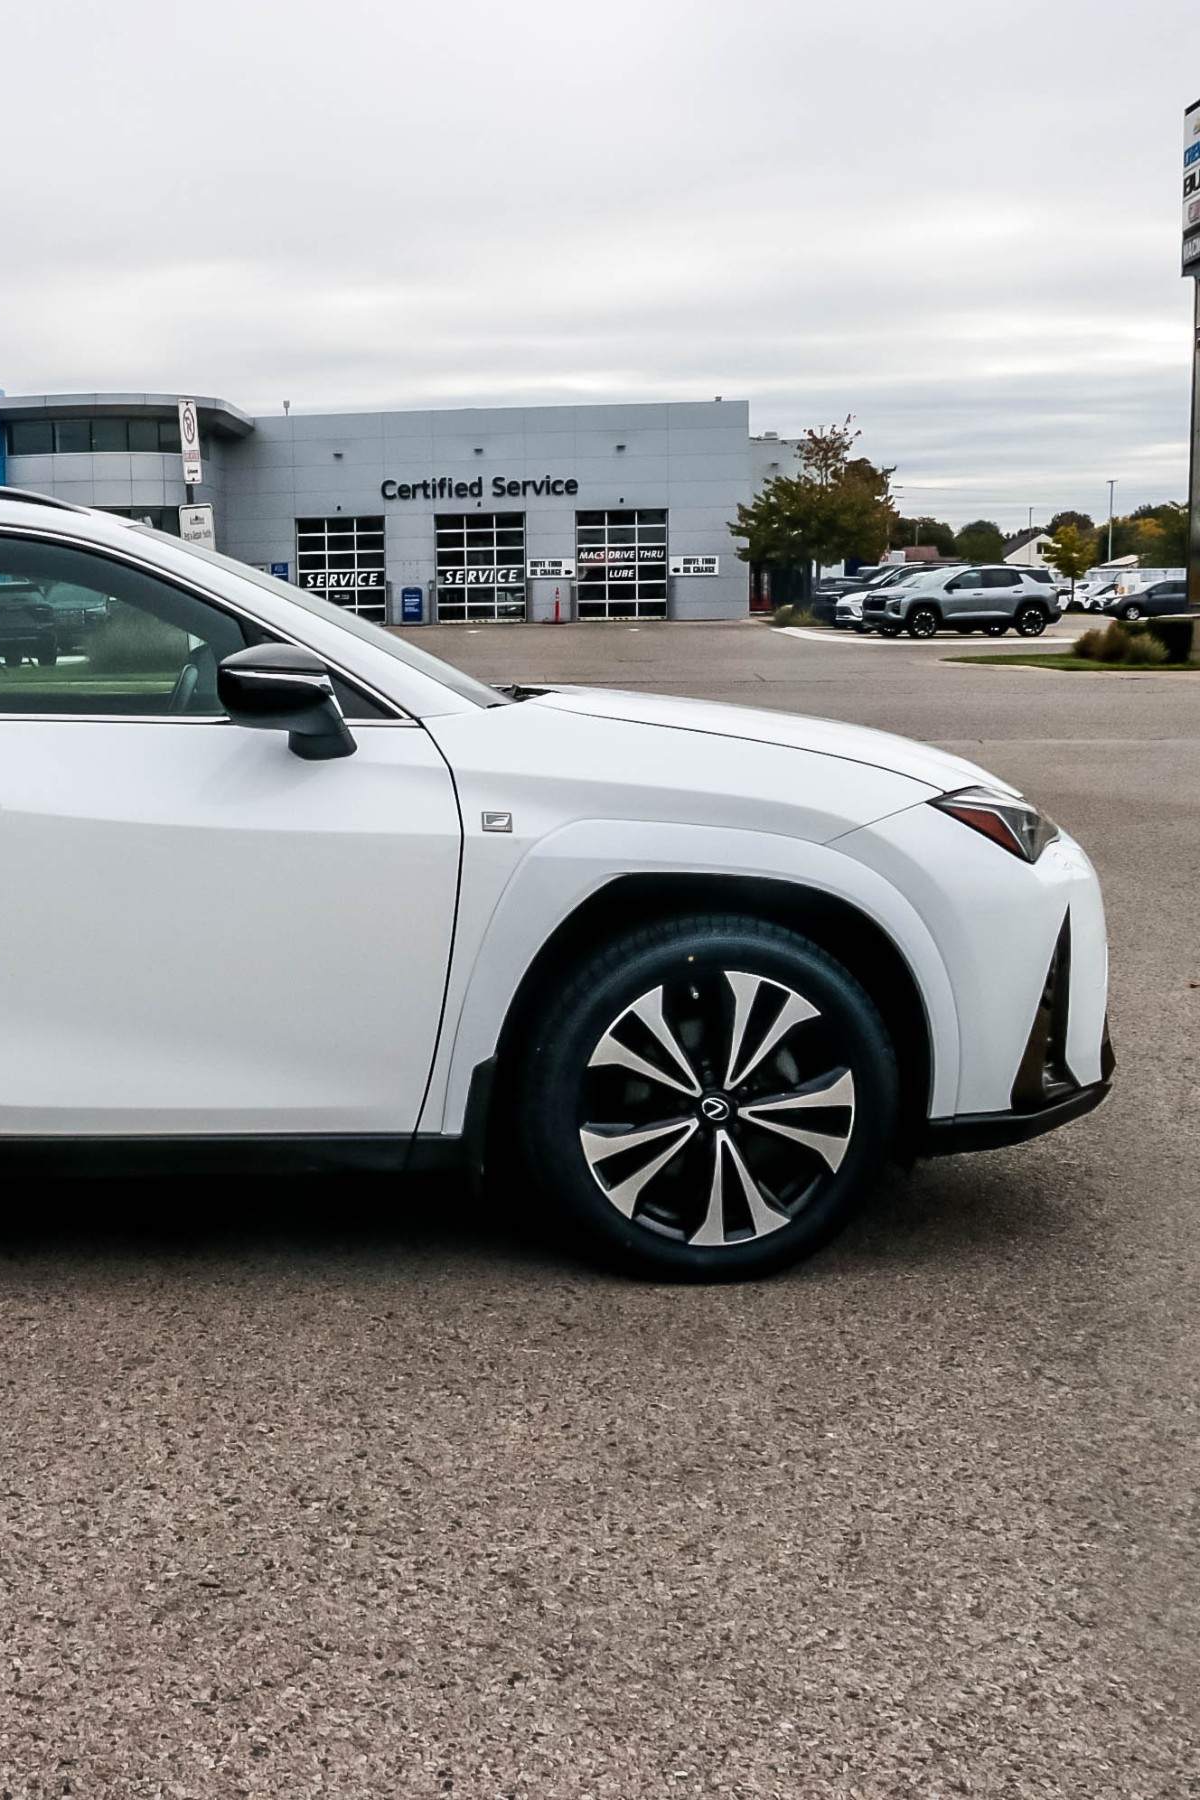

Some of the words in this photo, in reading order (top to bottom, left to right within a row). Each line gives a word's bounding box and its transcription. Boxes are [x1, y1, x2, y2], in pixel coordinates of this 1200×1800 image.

[380, 476, 483, 500] Certified
[492, 475, 579, 497] Service
[579, 551, 605, 560] MACS
[608, 550, 636, 560] DRIVE
[639, 549, 664, 559] THRU
[306, 572, 379, 588] SERVICE
[444, 569, 519, 584] SERVICE
[609, 569, 635, 578] LUBE
